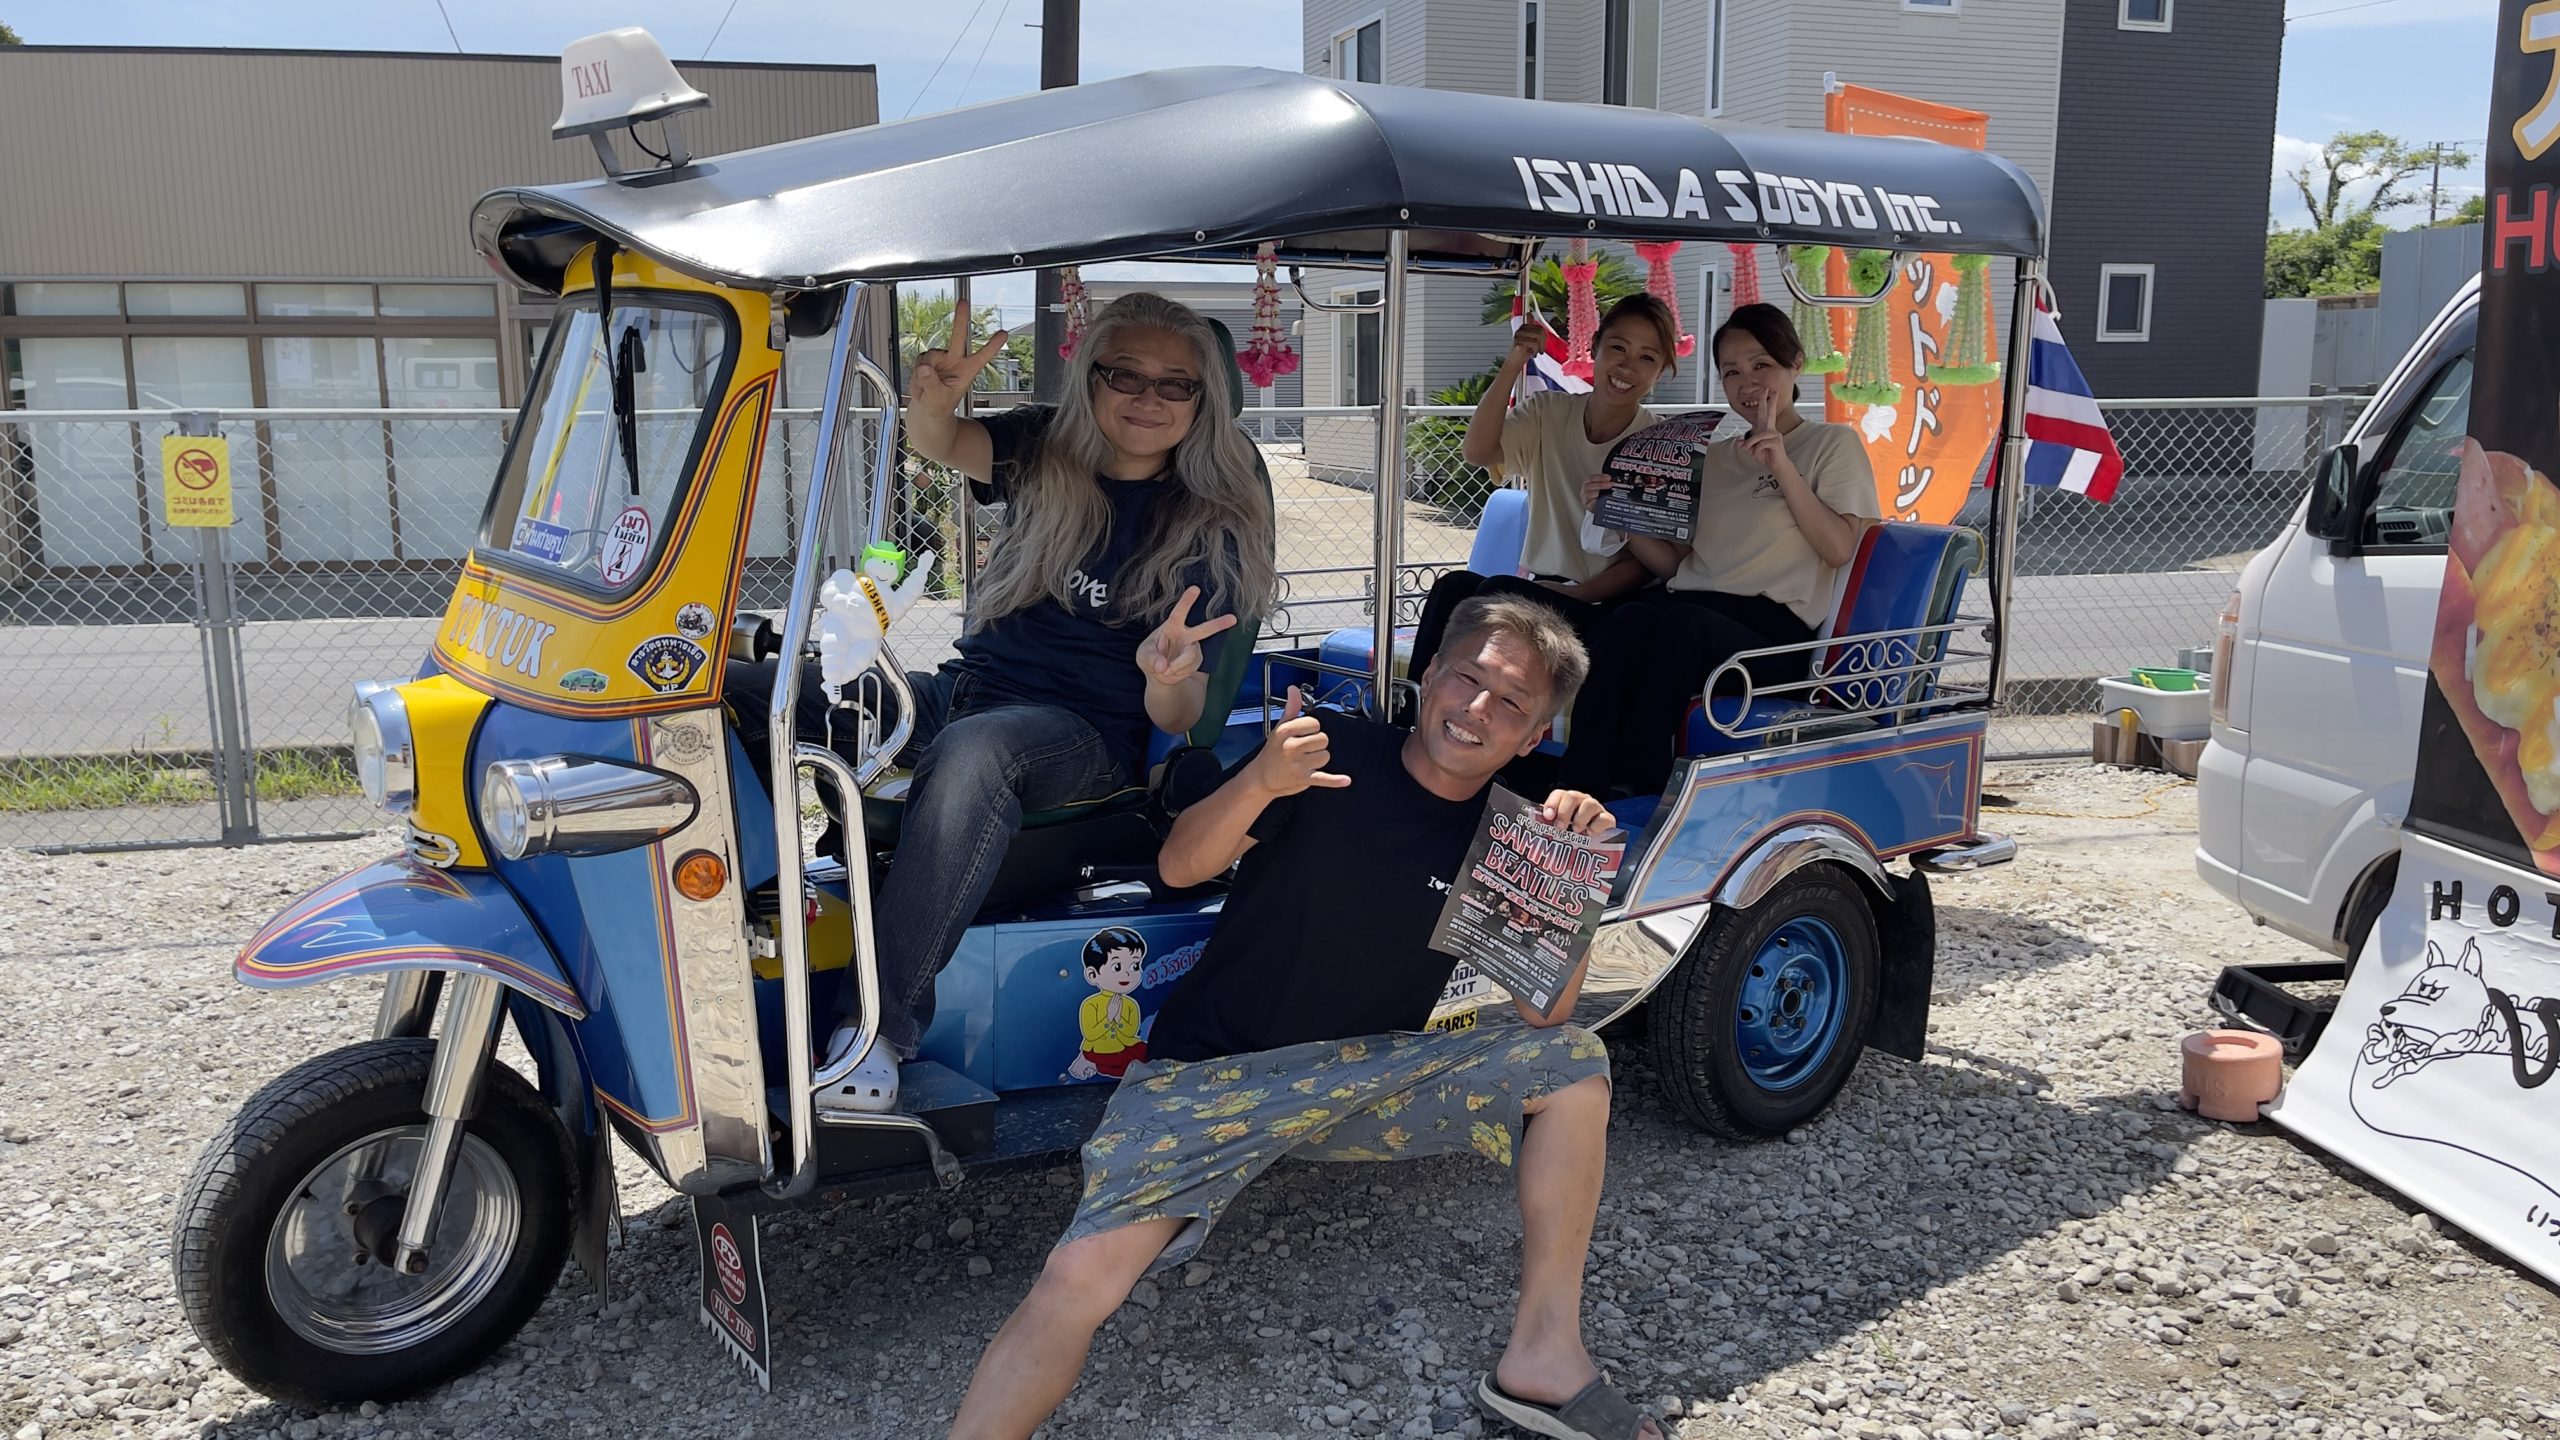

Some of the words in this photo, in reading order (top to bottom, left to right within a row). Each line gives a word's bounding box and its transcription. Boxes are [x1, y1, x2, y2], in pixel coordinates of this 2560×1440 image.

[571, 59, 612, 98] TAXI
[1714, 170, 1878, 230] SOGYO
[2493, 189, 2560, 270] H
[1893, 258, 1941, 523] ットドッ
[1620, 438, 1694, 466] BEATLES
[1069, 569, 1109, 608] ove
[1485, 841, 1589, 916] BEATLES
[1490, 813, 1572, 876] SAMMU
[1571, 848, 1608, 887] DE
[1441, 981, 1476, 1000] EXIT
